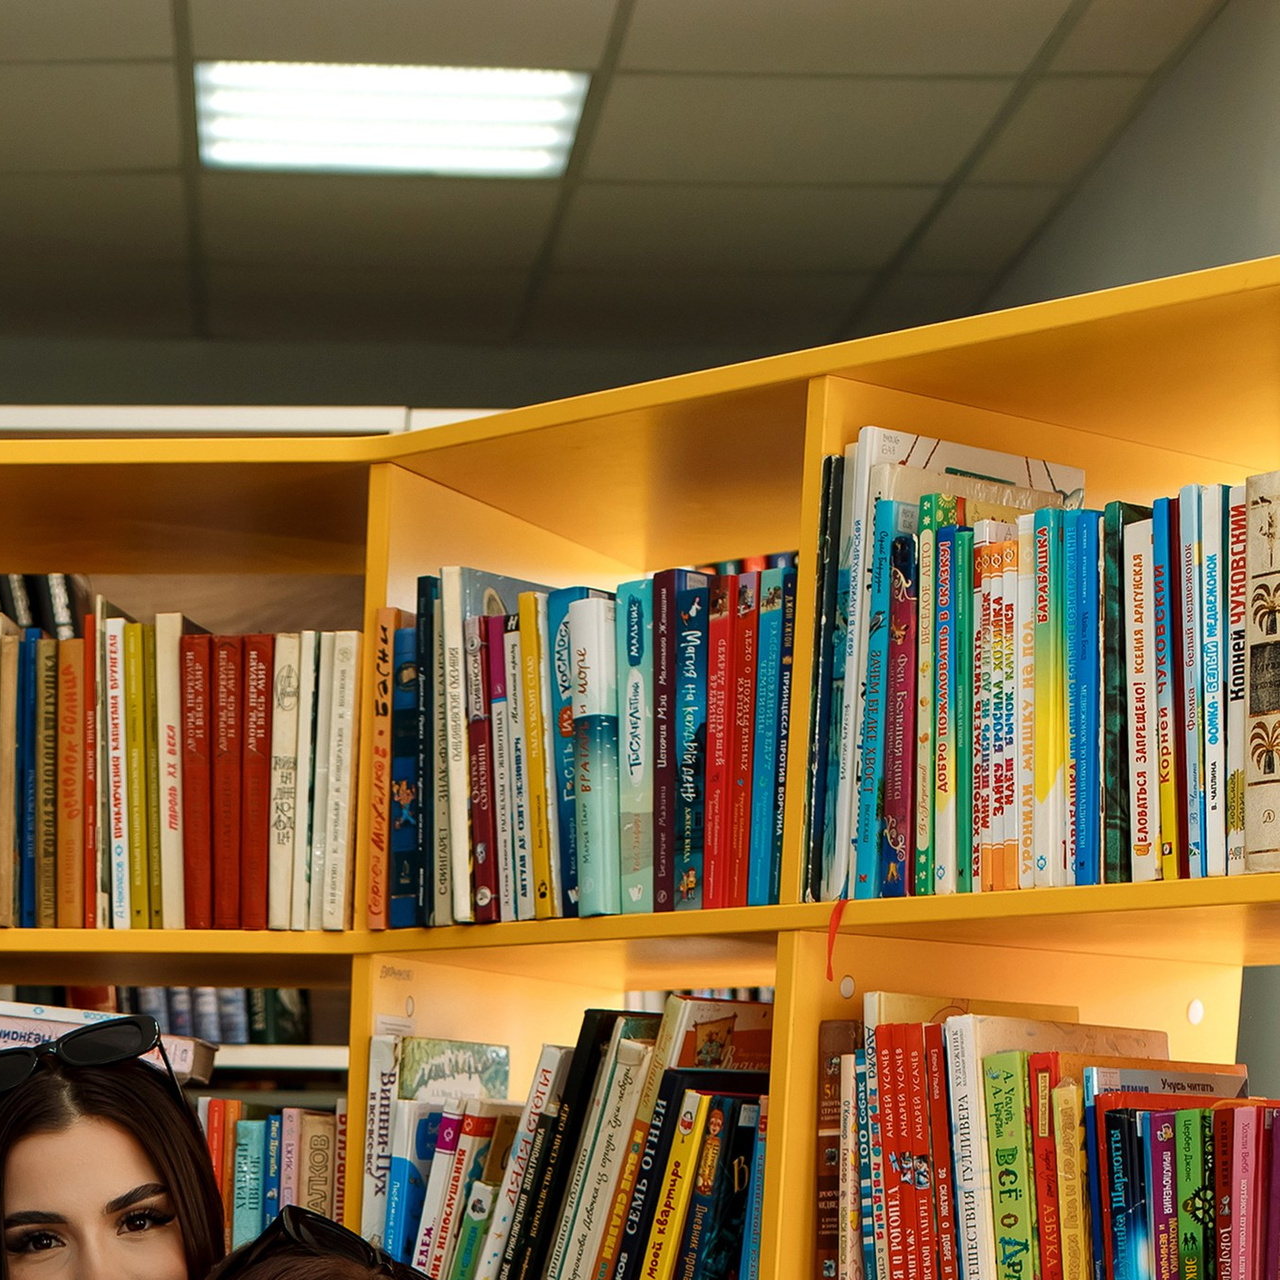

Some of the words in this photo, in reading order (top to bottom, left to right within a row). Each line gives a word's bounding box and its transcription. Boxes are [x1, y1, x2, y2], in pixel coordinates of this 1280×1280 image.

[939, 541, 951, 612] СКАЗКУ!
[1037, 526, 1049, 624] БАРАБАШКА
[1133, 553, 1143, 624] ДРАГУНСКАЯ
[1229, 504, 1246, 624] ЧУКОВСКИЙ
[1206, 553, 1218, 641] МЕДВЕЖОНОК
[110, 634, 118, 690] ВРУНГЕЛЯ
[870, 650, 882, 692] ЗАЧЕМ
[1135, 629, 1144, 674] КСЕНИЯ
[1206, 647, 1219, 691] БЕЛЫЙ
[780, 672, 791, 736] ПРИНЦЕССА
[938, 631, 950, 739] ПОЖАЛОВАТЬ
[111, 695, 120, 751] КАПИТАНА
[167, 725, 176, 756] ВЕКА
[867, 696, 880, 739] БЕЛКЕ
[1136, 681, 1147, 764] ЗАПРЕЩЕНО!
[1207, 703, 1219, 746] ФОМКА
[778, 740, 787, 784] ПРОТИВ
[864, 742, 878, 793] ХВОСТ
[937, 744, 948, 793] ДОБРО
[112, 756, 124, 839] ПРИКЛЮЧЕНИЯ
[169, 786, 178, 830] ПАРОЛЬ
[776, 790, 785, 836] ВОРЧУНА
[1133, 771, 1148, 858] ЦЕЛОВАТЬСЯ
[881, 1048, 891, 1091] УСАЧЕВ
[895, 1047, 904, 1090] УСАЧЕВ
[911, 1050, 920, 1091] УСАЧЕВ
[1161, 1078, 1180, 1092] Учусь
[1180, 1080, 1215, 1093] читать
[884, 1094, 895, 1139] АНДРЕЙ
[899, 1093, 908, 1138] АНДРЕЙ
[914, 1094, 924, 1141] АНДРЕЙ
[960, 1094, 976, 1183] ГУЛЛИВЕРА
[626, 1173, 649, 1235] СЕМЬ
[641, 1098, 667, 1170] ОГНЕЙ
[996, 1146, 1019, 1205] ВСЁ
[646, 1240, 664, 1276] моей
[655, 1159, 681, 1239] квартире
